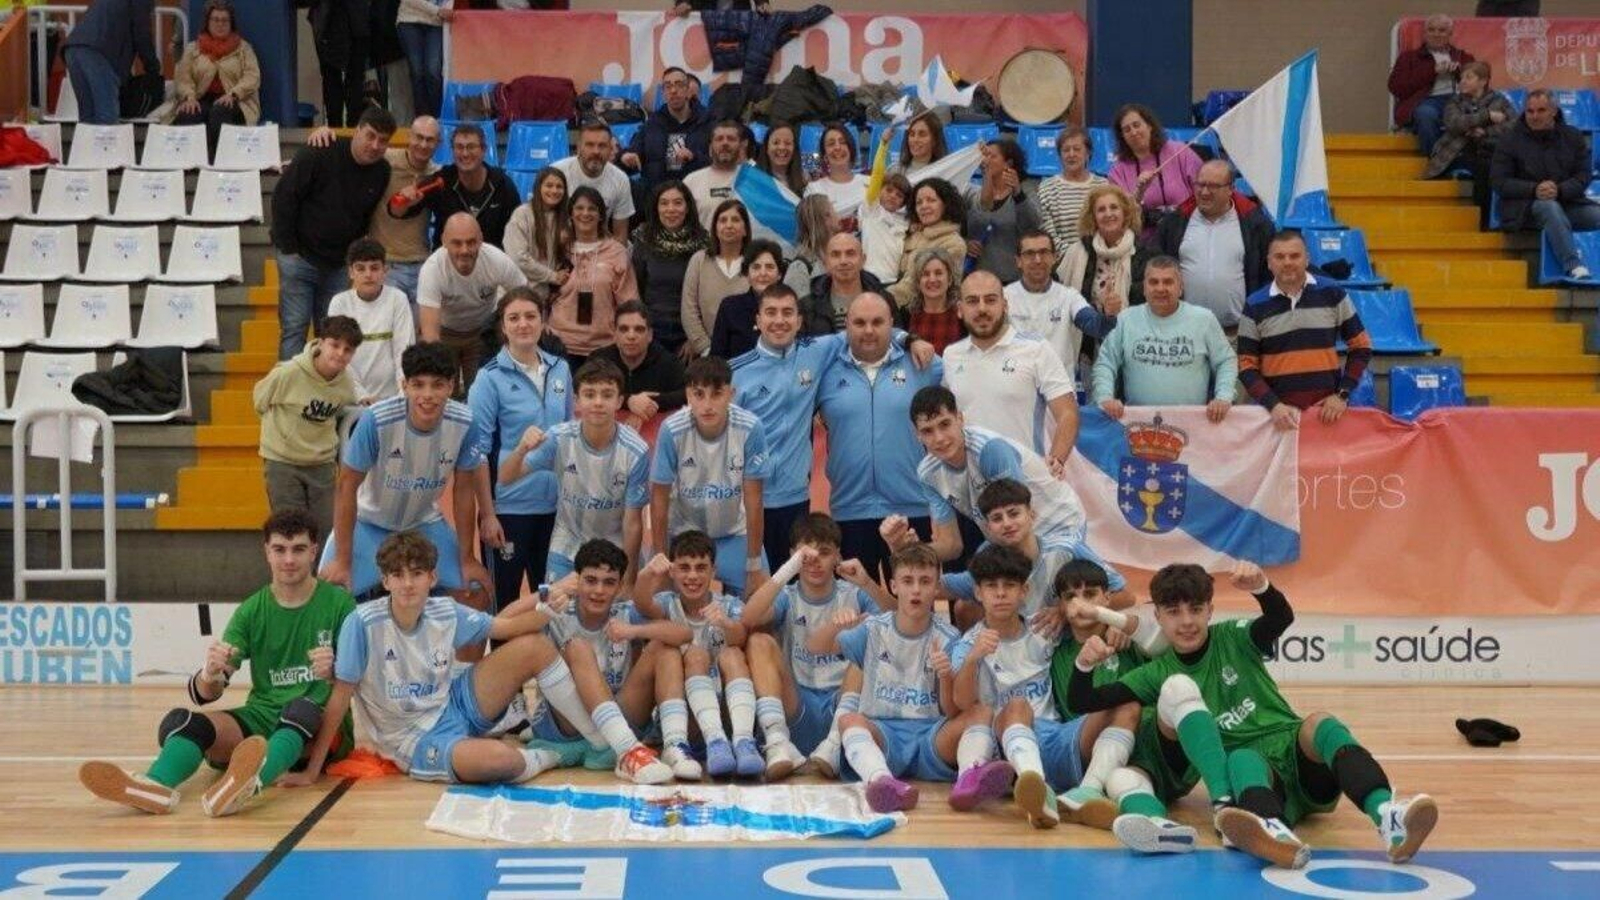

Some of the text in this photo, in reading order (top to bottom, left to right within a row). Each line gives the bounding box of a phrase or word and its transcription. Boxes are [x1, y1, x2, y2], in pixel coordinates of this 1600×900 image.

[1580, 51, 1600, 77] L
[1135, 344, 1192, 358] SALSA
[1526, 452, 1600, 541] J
[1374, 625, 1501, 662] saúde
